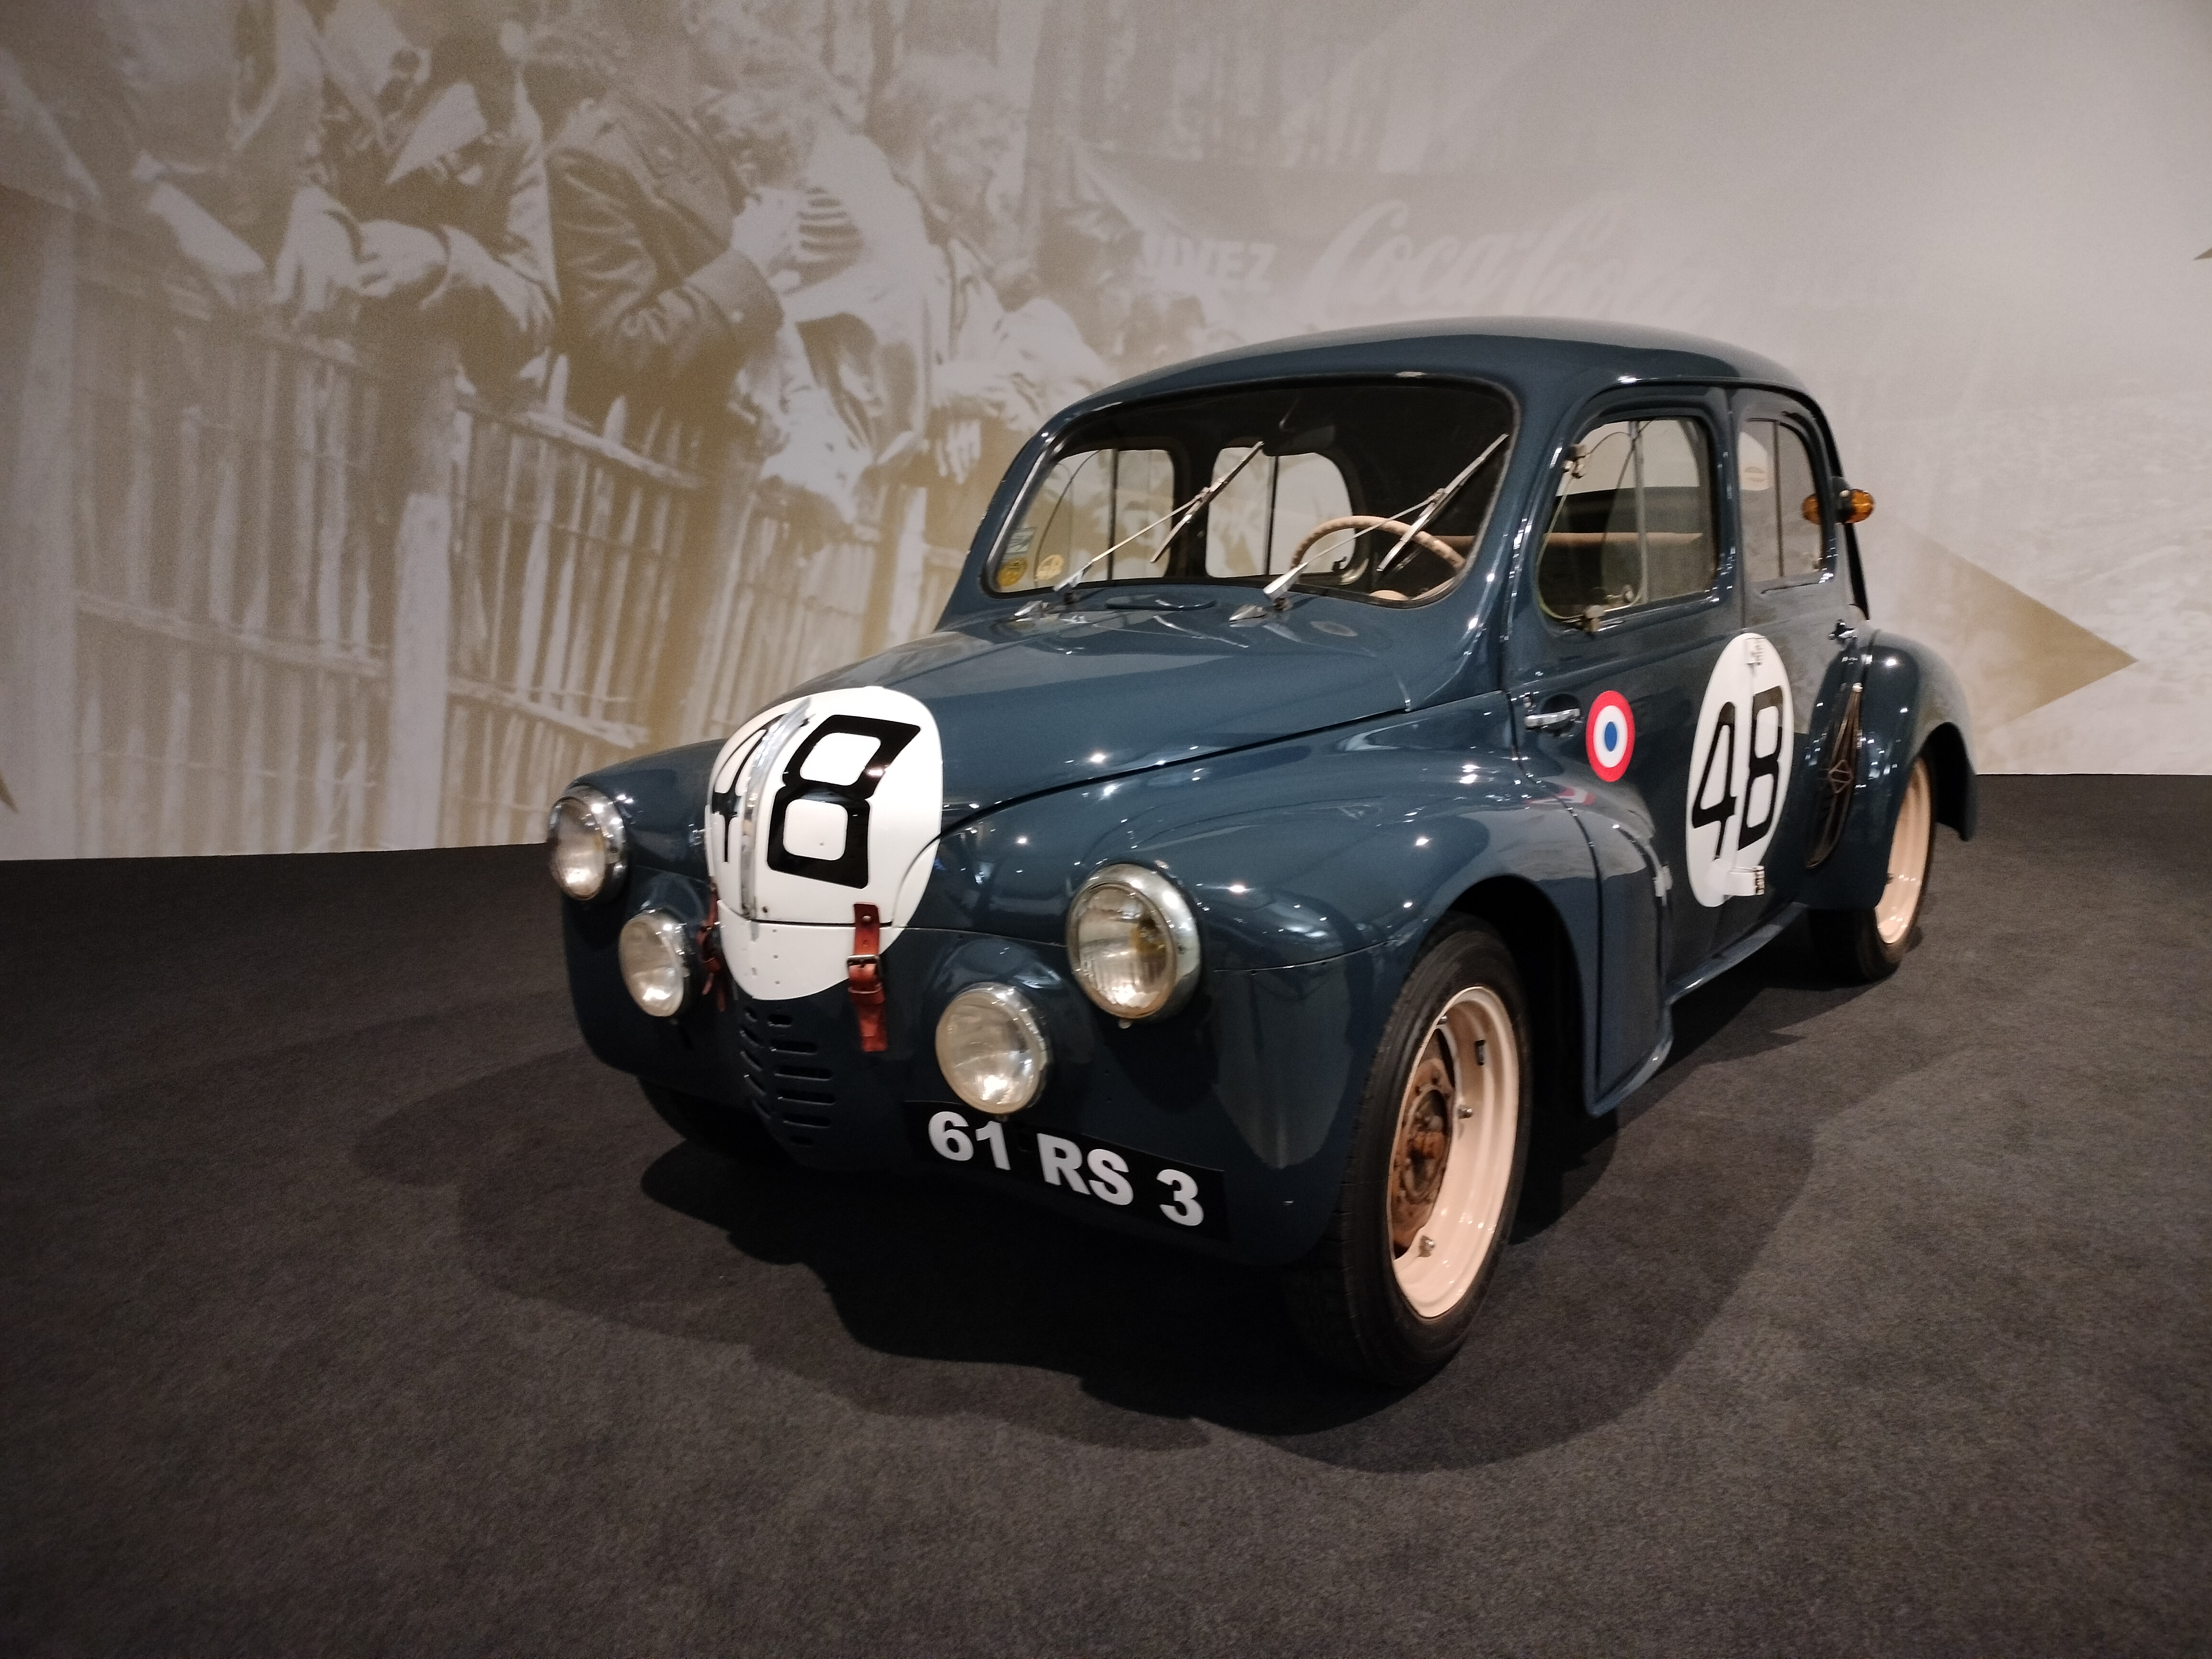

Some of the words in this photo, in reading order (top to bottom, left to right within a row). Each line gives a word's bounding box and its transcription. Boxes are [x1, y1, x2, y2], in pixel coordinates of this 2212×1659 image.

[1692, 685, 1784, 860] 48
[929, 1111, 1011, 1170] 61
[1037, 1133, 1134, 1206] RS
[1157, 1169, 1204, 1226] 3
